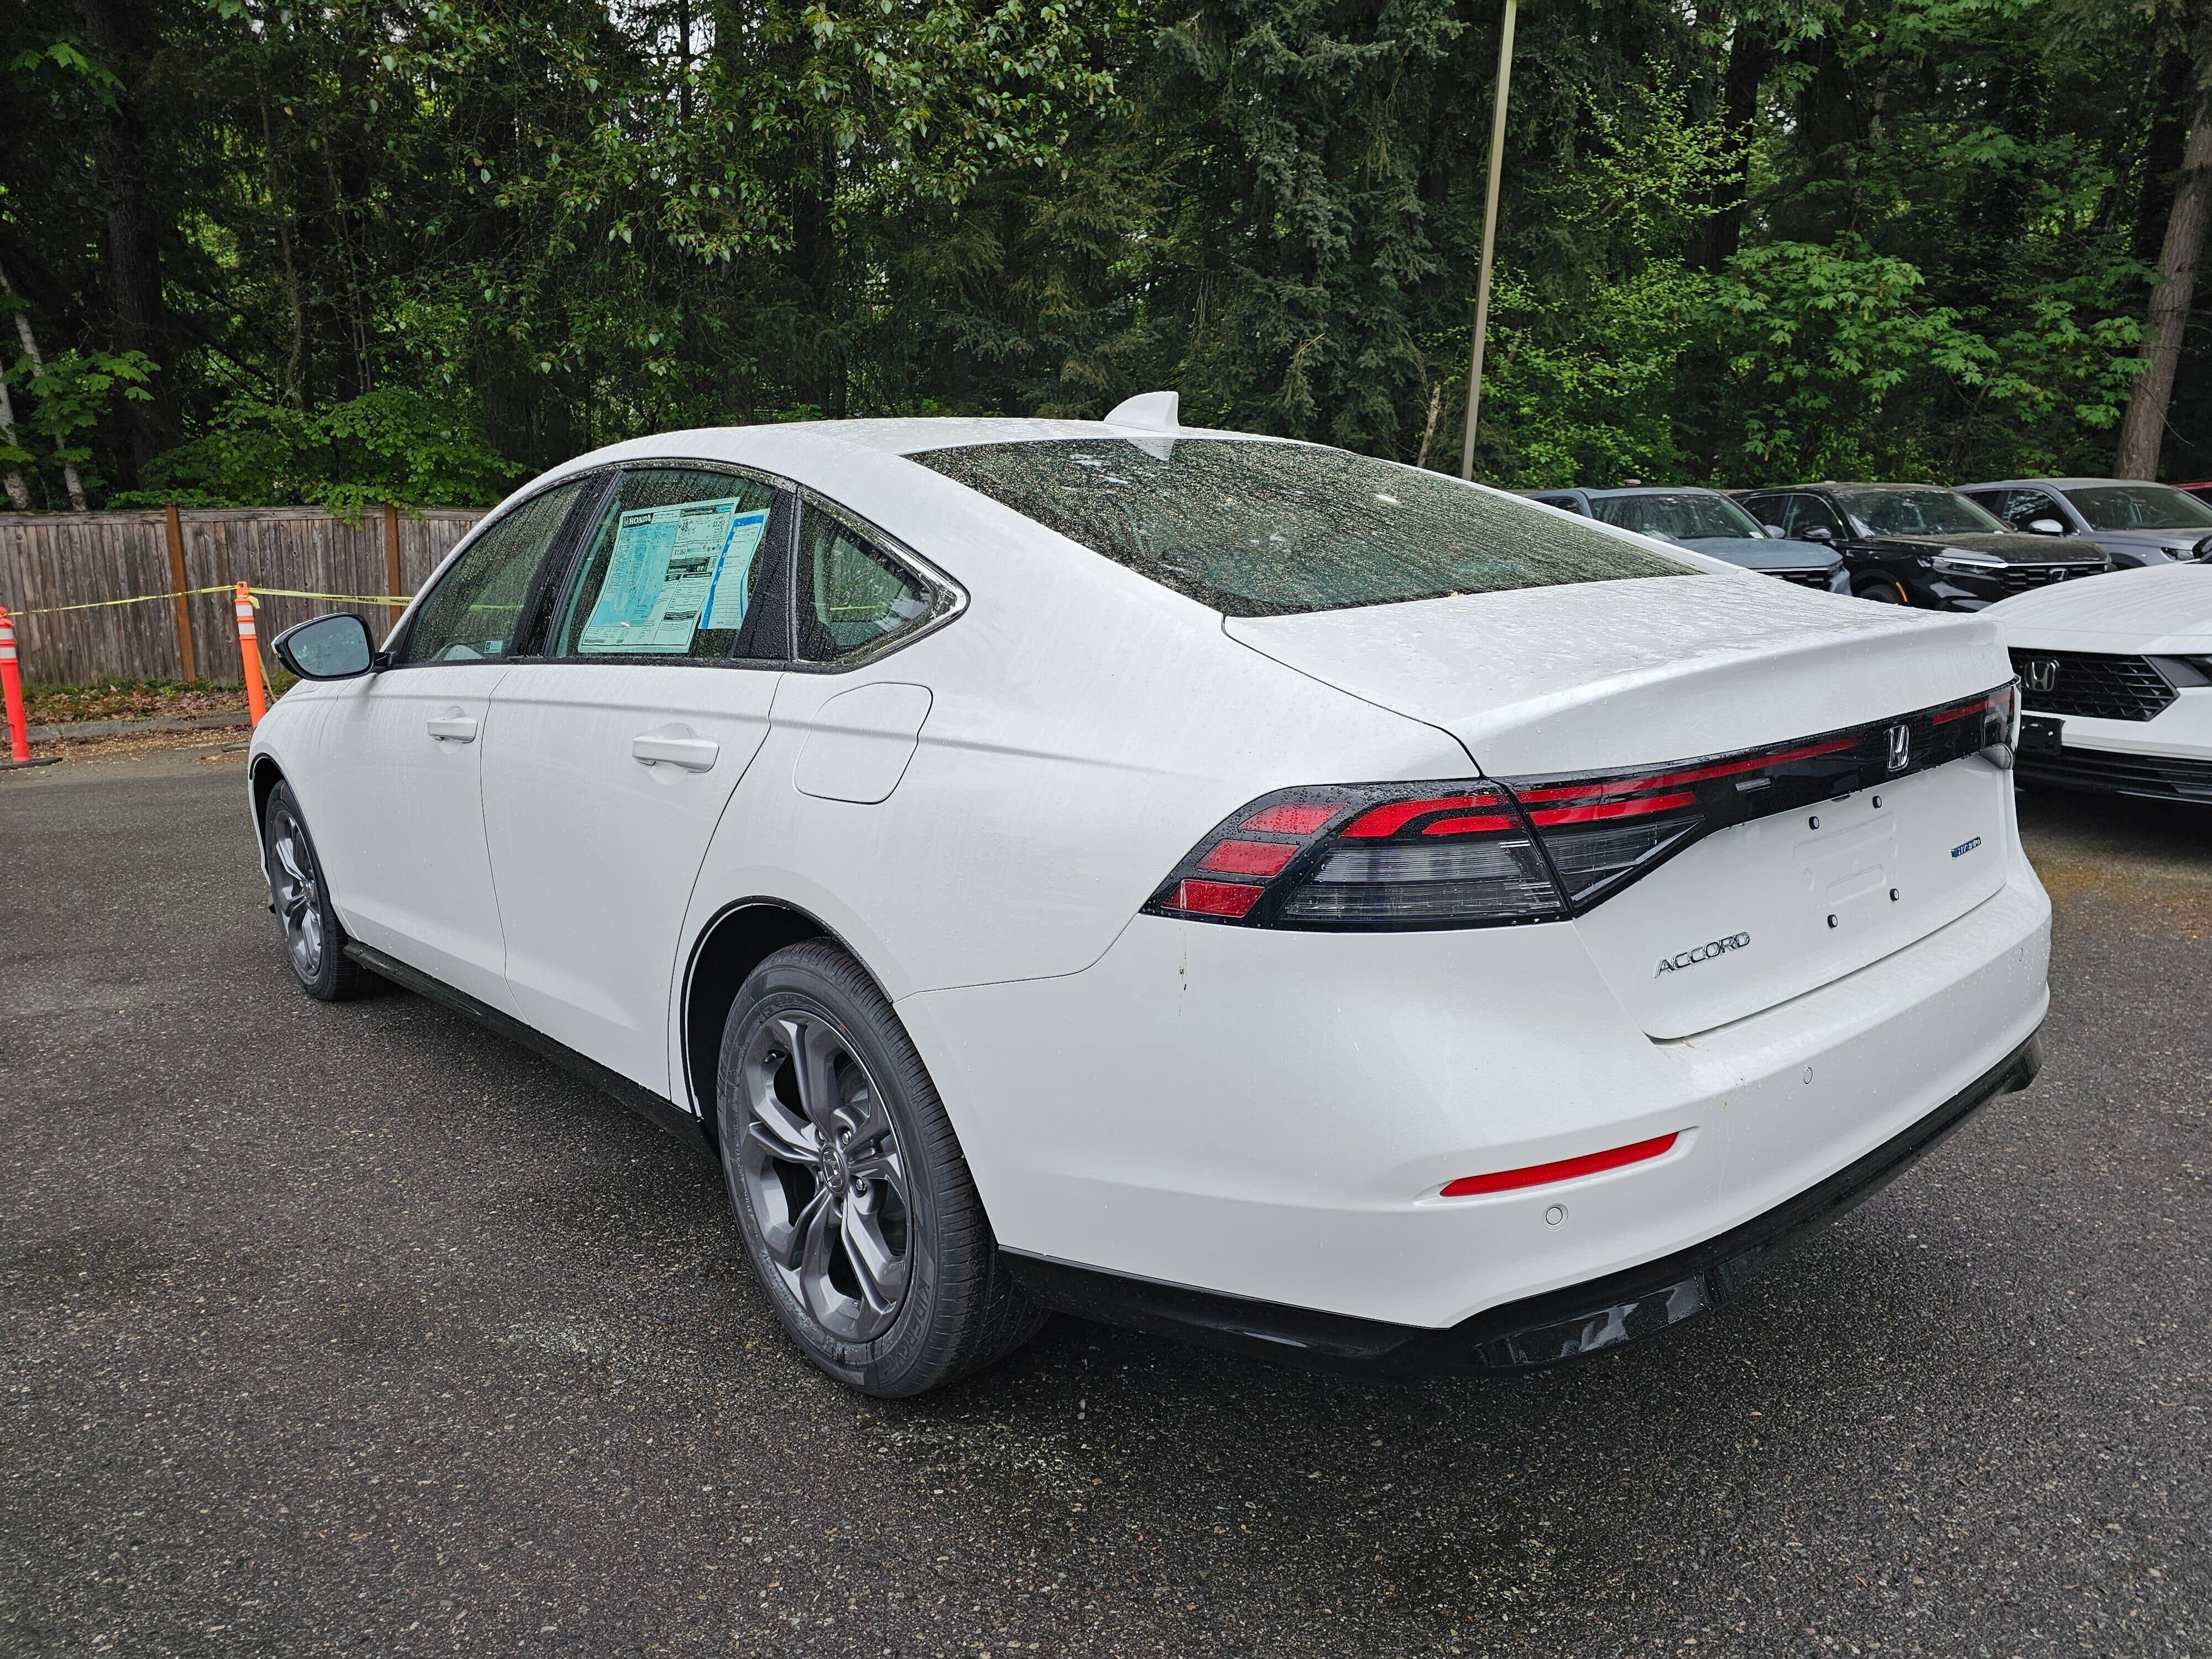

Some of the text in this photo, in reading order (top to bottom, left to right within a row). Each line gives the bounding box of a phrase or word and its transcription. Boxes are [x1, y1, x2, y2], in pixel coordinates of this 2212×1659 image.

[629, 514, 651, 525] HONDA
[681, 521, 689, 532] 48
[1655, 932, 1750, 979] ACCORD
